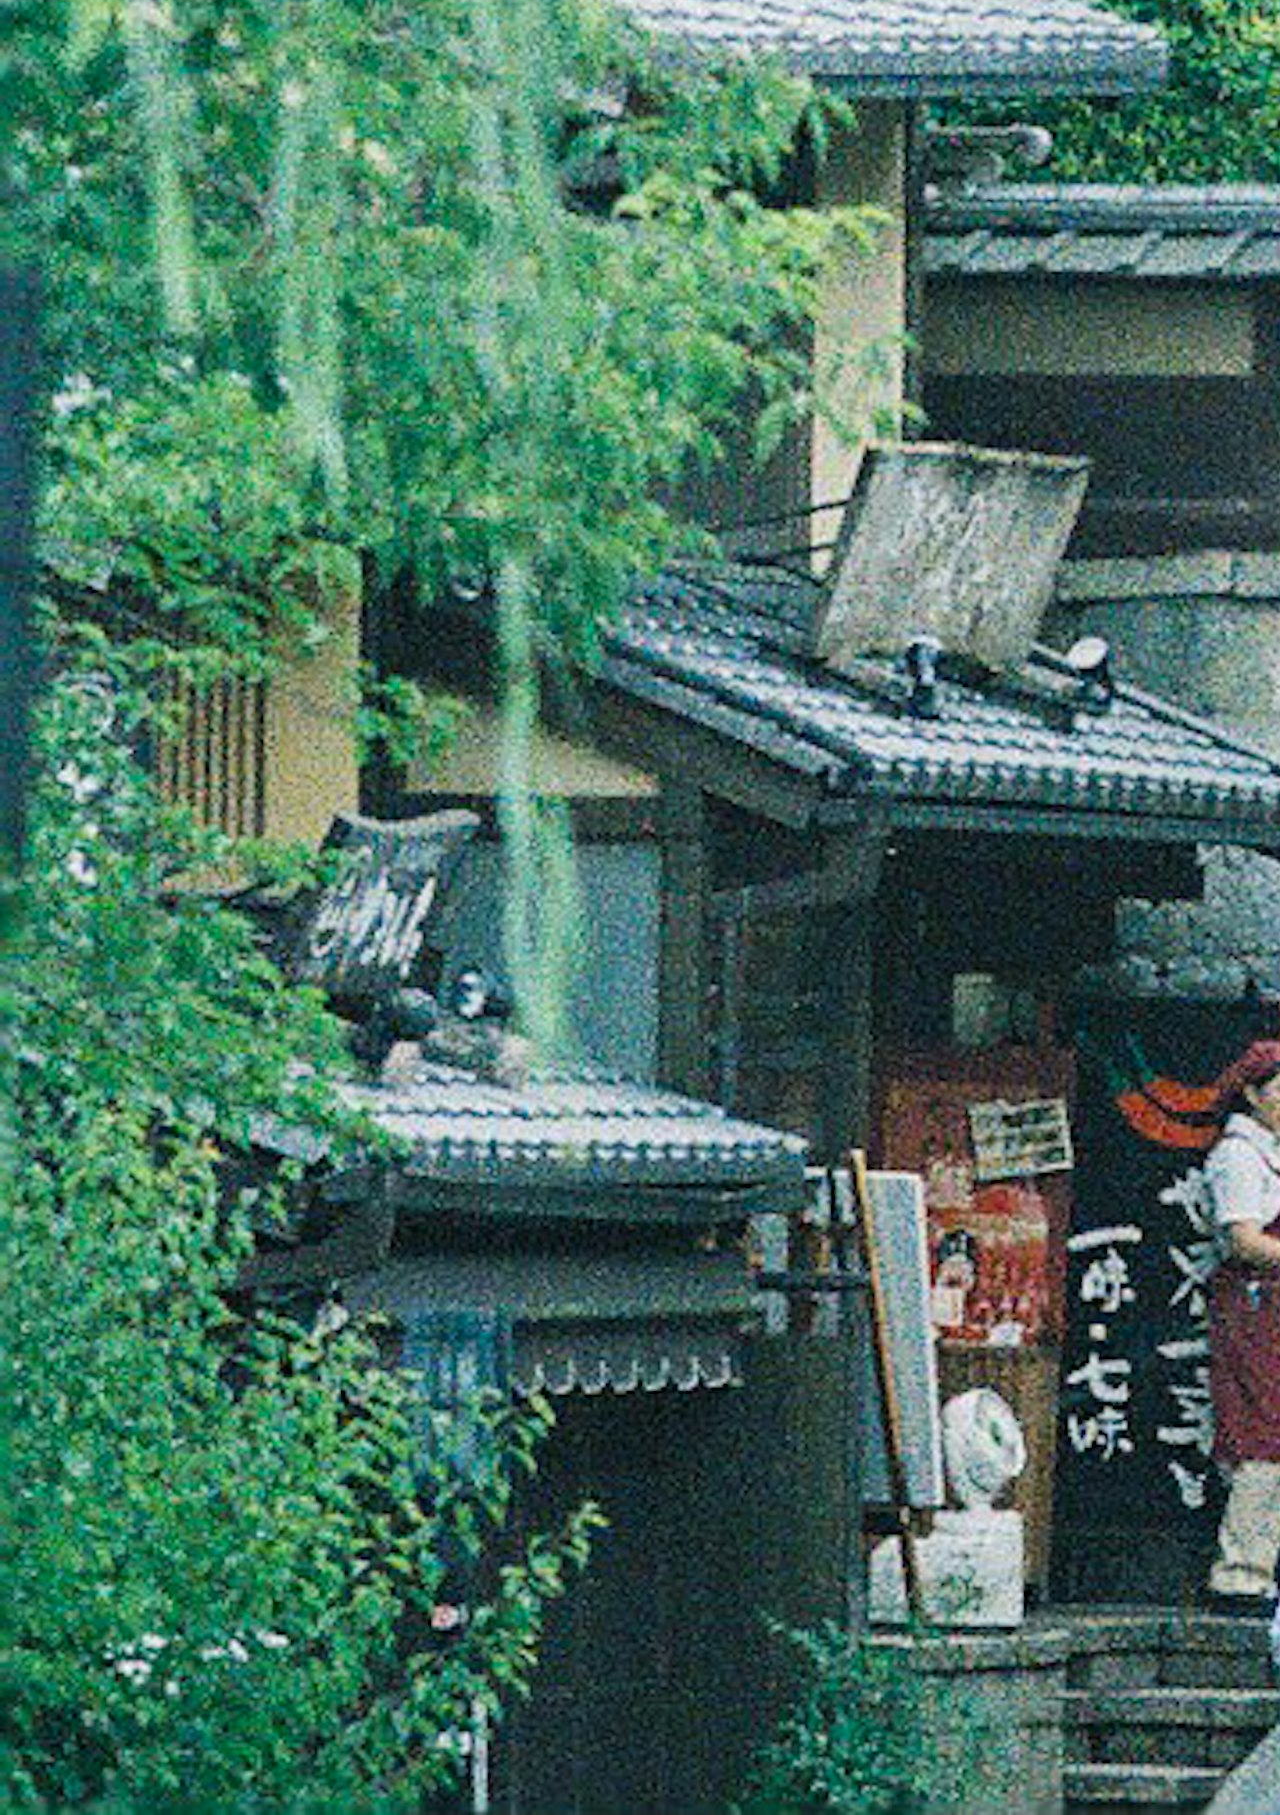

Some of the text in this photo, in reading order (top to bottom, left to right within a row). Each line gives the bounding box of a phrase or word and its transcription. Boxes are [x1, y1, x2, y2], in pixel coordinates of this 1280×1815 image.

[1065, 1223, 1143, 1462] 一味・七味
